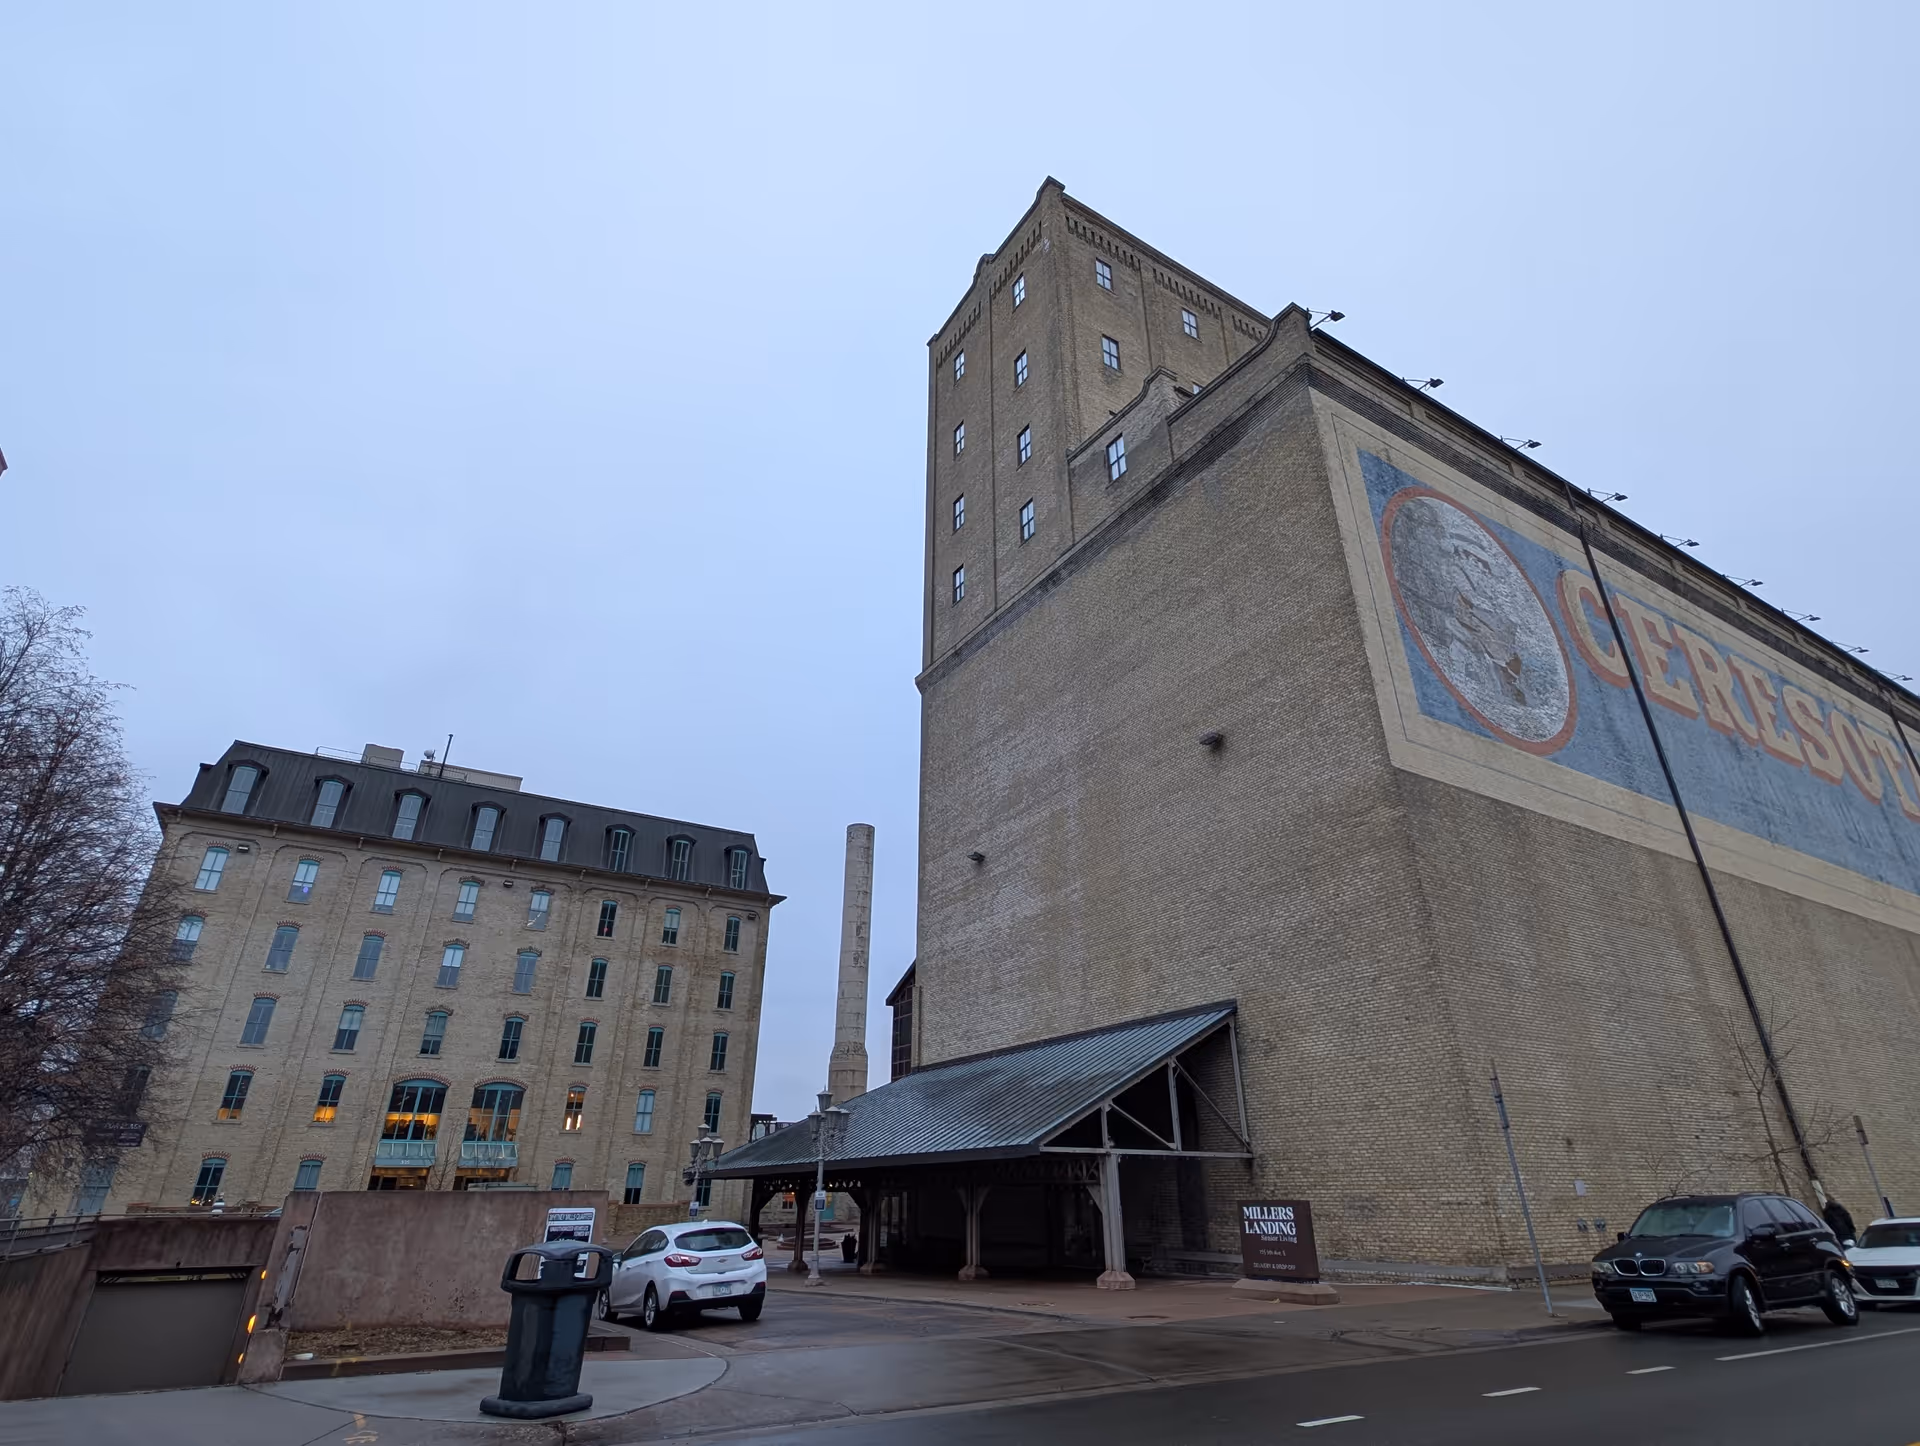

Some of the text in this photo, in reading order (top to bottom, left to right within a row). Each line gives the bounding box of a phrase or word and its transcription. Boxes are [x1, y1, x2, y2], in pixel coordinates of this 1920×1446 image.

[1243, 1206, 1294, 1220] MILLERS
[1244, 1221, 1296, 1235] LANDING
[1280, 1235, 1297, 1244] Living
